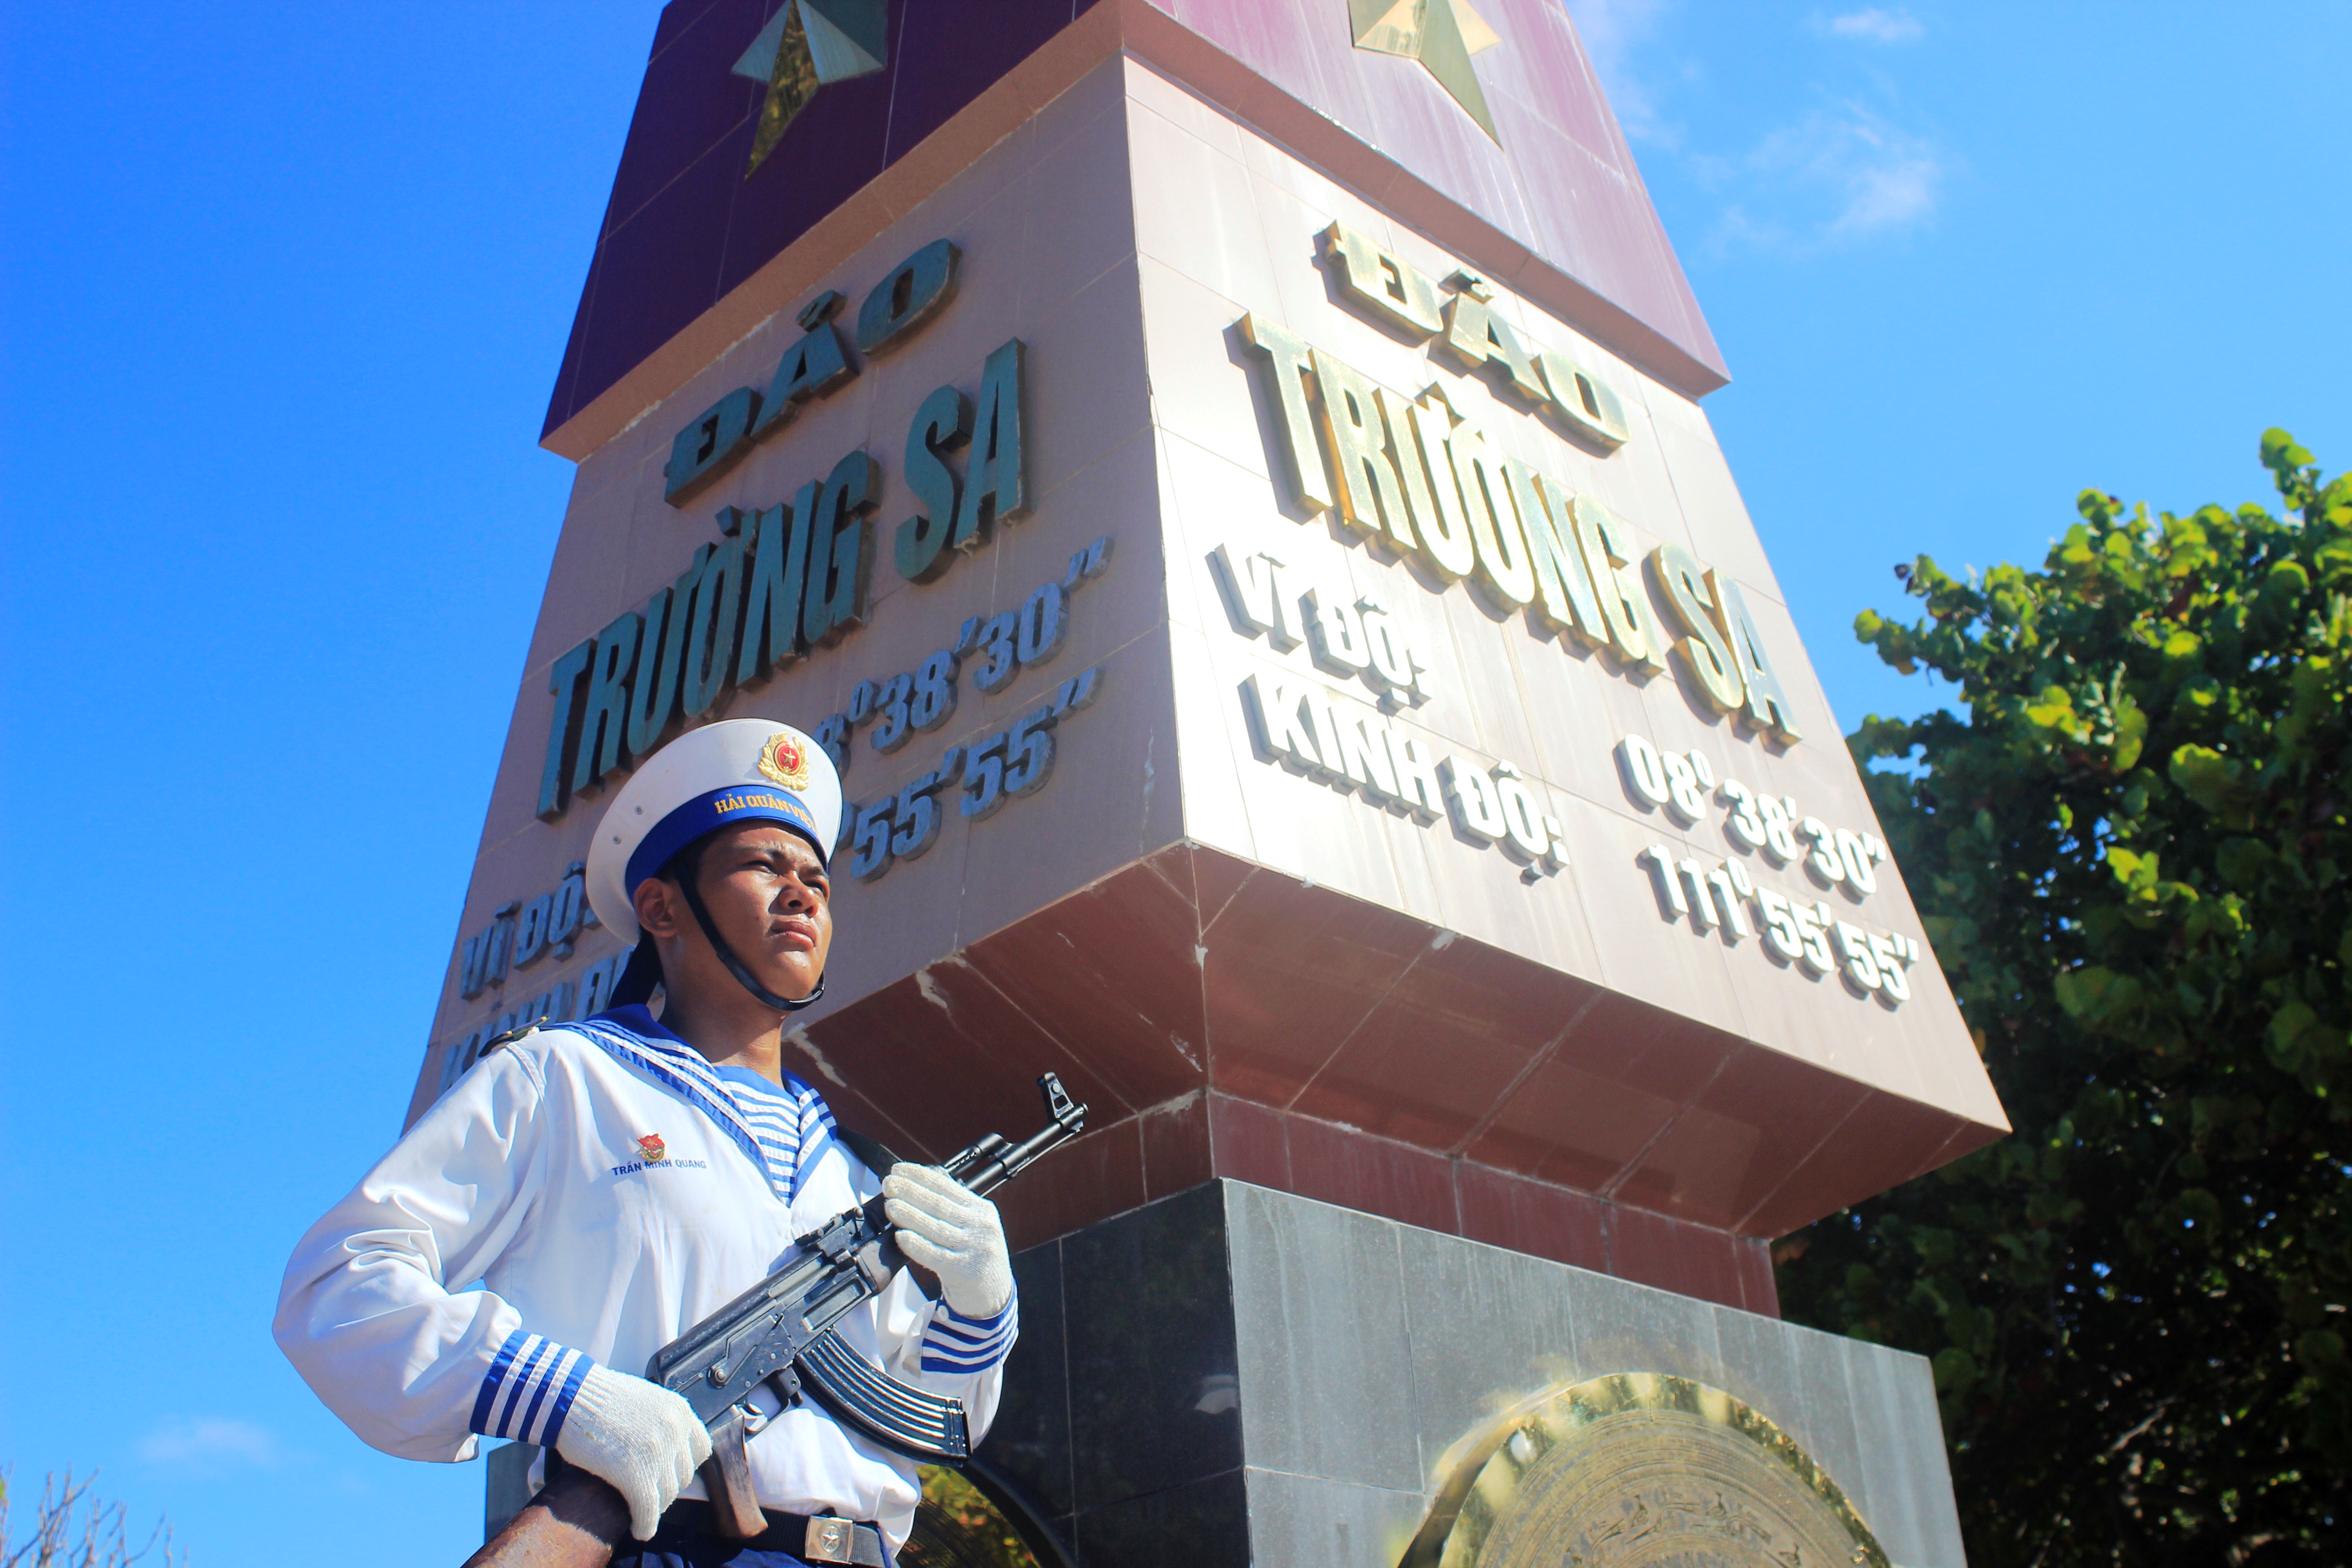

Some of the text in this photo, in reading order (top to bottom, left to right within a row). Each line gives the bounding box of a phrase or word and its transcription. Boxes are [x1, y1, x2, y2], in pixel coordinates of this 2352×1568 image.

[664, 238, 960, 506] ĐẢO
[1312, 220, 1631, 458] ĐẢO
[537, 337, 1030, 819] TRƯỜNG SA
[1222, 310, 1802, 757] TRƯỜNG SA
[714, 793, 746, 813] HẢI
[745, 793, 790, 813] QUÂN
[1237, 673, 1445, 829] KINH
[644, 1159, 673, 1170] MINH
[675, 1159, 707, 1169] QUANG
